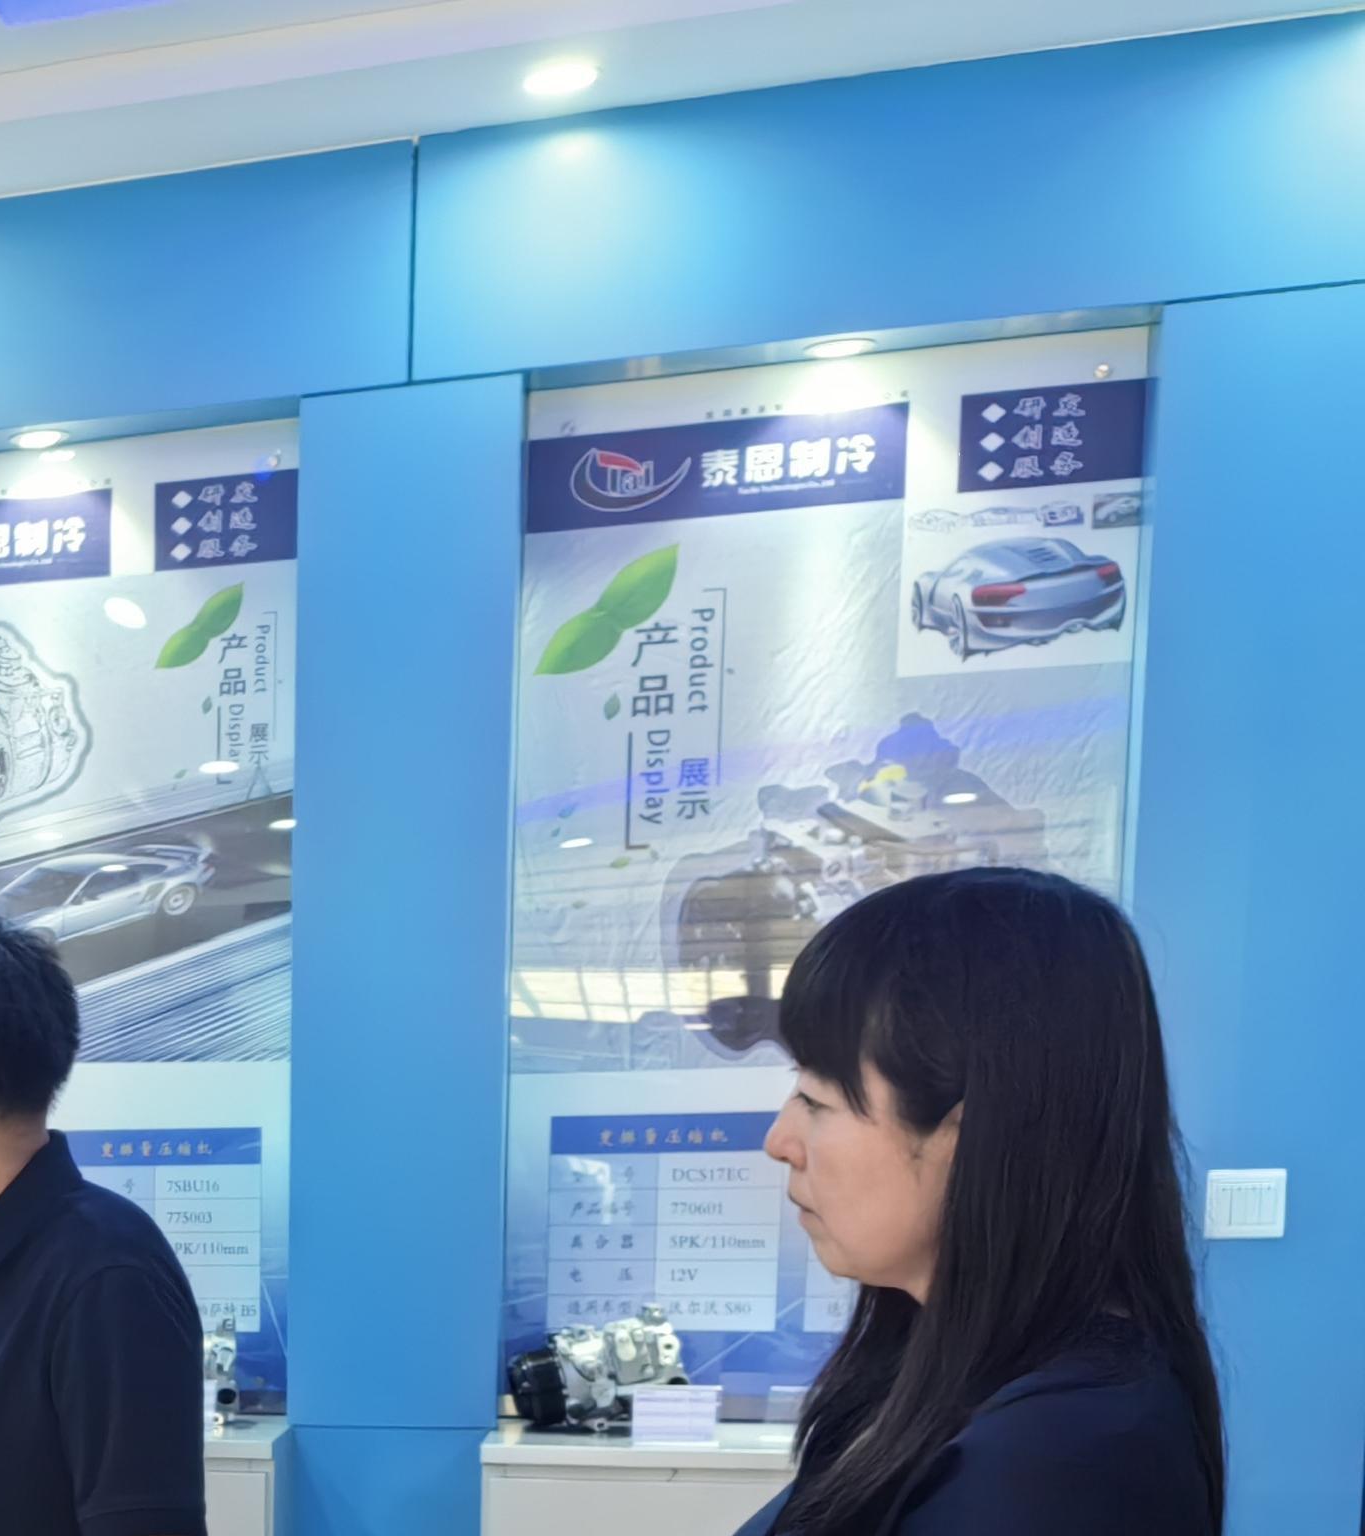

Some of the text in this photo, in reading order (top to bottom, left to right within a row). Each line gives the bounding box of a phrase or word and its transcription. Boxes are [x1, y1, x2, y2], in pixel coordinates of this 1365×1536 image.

[701, 434, 876, 489] 泰恩制冷
[218, 633, 248, 696] 产品
[253, 624, 271, 694] Product
[631, 621, 679, 718] 产品
[687, 607, 716, 714] Product
[225, 703, 246, 764] Displa
[248, 722, 270, 764] 展示
[639, 729, 672, 825] Display
[677, 757, 711, 820] 展示
[173, 1242, 250, 1255] PK/110mm
[670, 1268, 699, 1282] 12V
